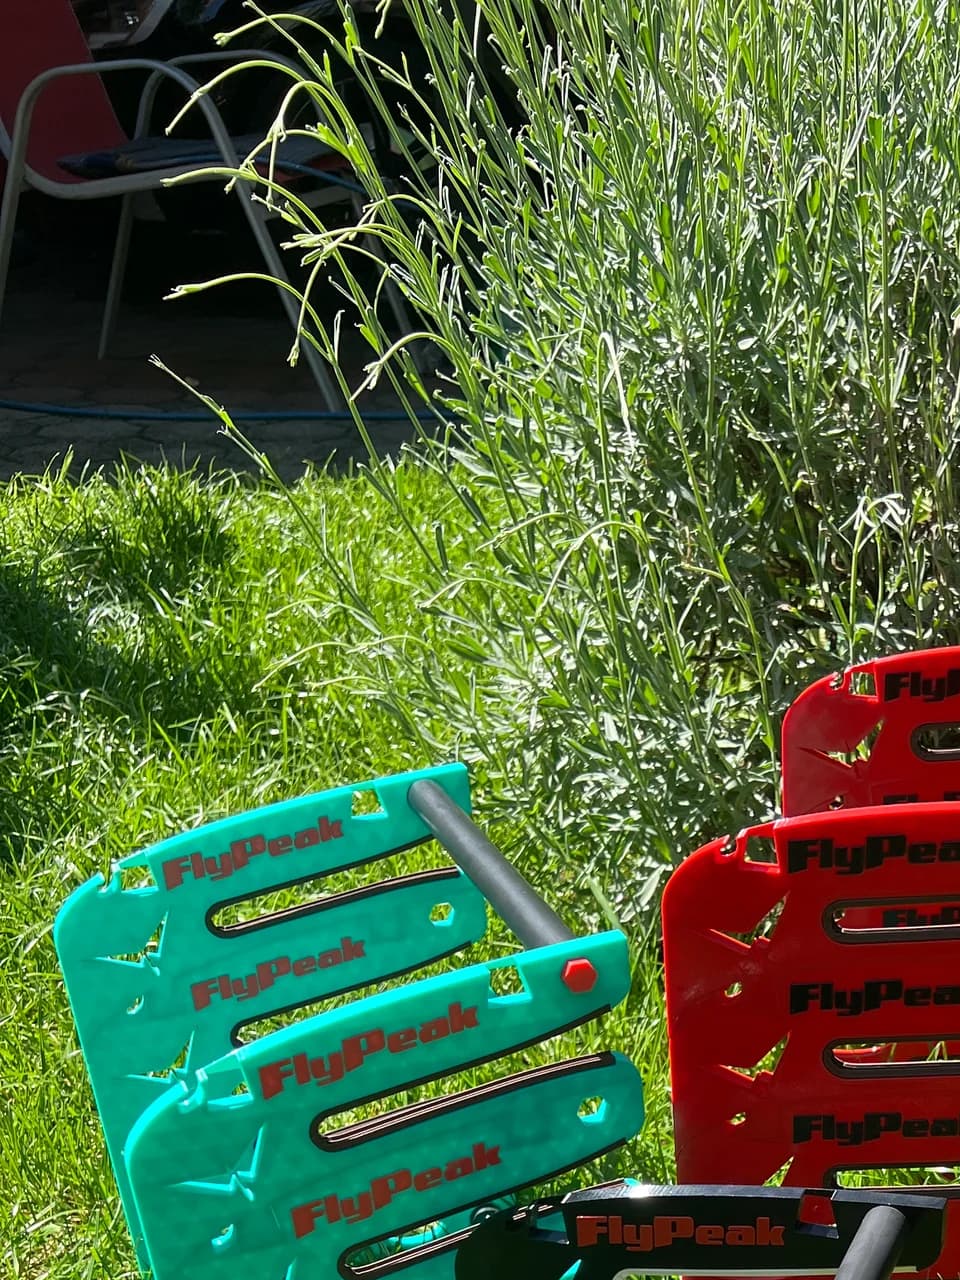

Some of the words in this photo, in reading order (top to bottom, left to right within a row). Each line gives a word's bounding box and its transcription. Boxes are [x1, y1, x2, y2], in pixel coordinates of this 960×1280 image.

[163, 816, 344, 890] FlyPeak
[190, 937, 366, 1011] FlyPeak
[259, 1001, 480, 1101] FlyPeak
[290, 1142, 502, 1239] FlyPeak
[575, 1215, 786, 1252] FlyPeak
